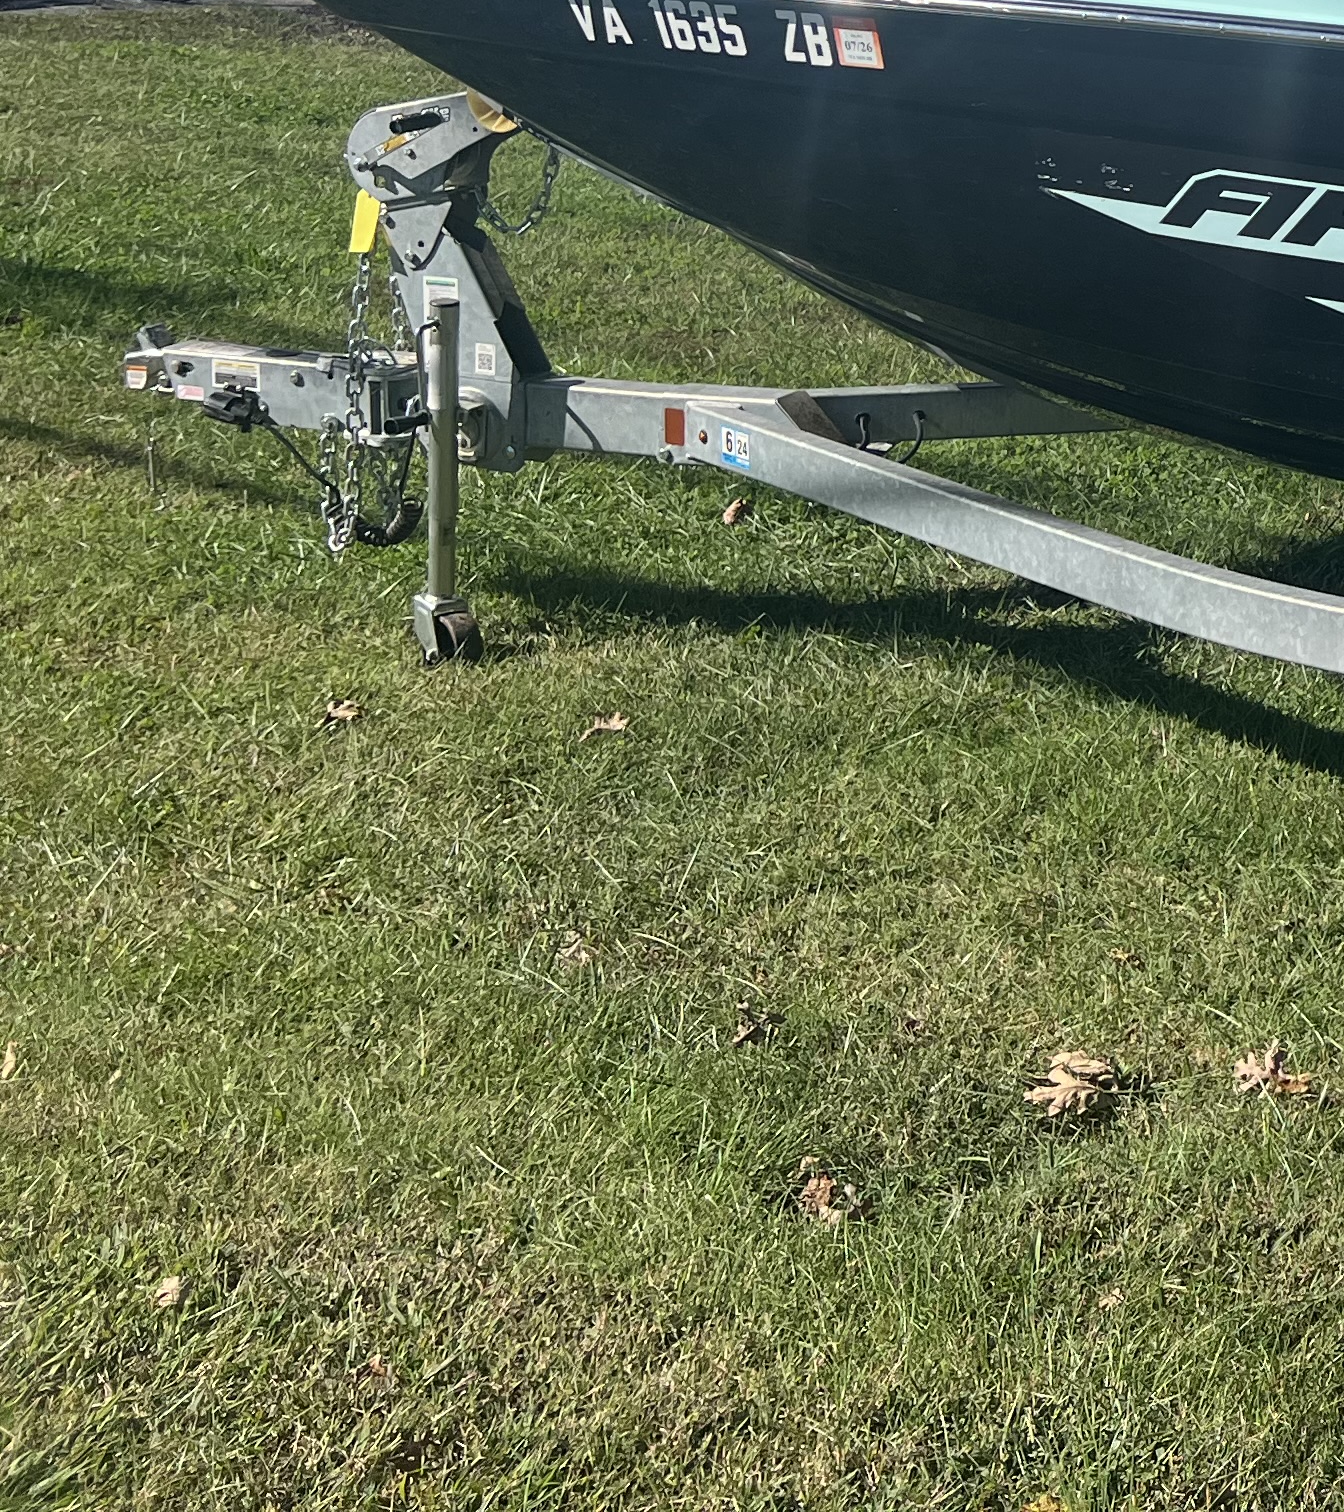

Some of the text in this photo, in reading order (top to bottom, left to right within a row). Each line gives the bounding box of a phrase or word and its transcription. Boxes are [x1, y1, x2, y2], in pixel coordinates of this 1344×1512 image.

[775, 8, 834, 67] ZB
[844, 40, 873, 53] 07/26
[725, 430, 748, 457] 6 24
